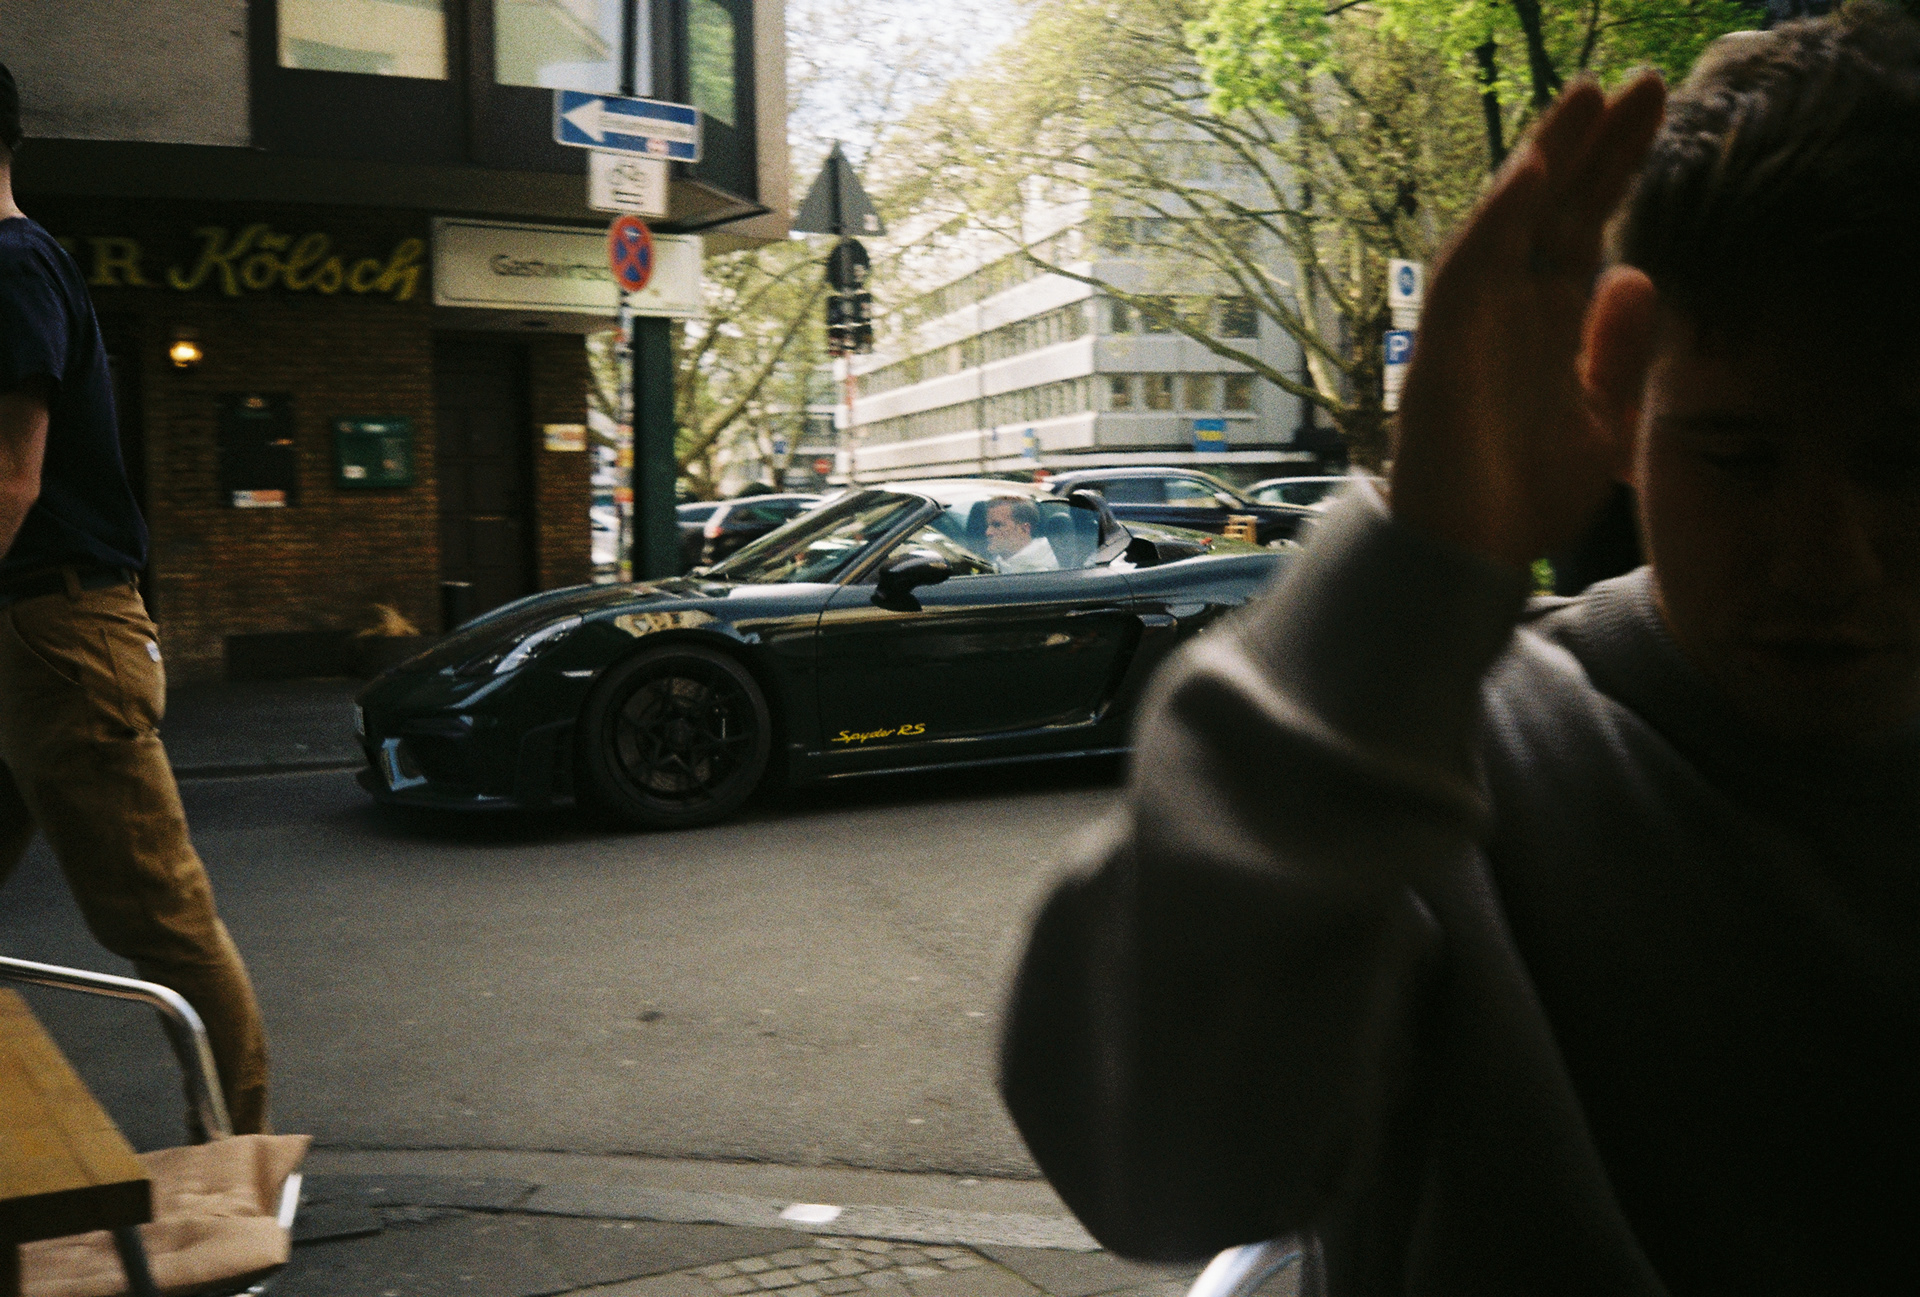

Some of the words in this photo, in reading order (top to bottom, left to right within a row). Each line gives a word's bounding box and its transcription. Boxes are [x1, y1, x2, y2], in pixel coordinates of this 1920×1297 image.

[167, 223, 425, 301] Kölsch
[1389, 335, 1410, 361] P
[831, 727, 896, 744] Spyder
[896, 722, 927, 736] RS
